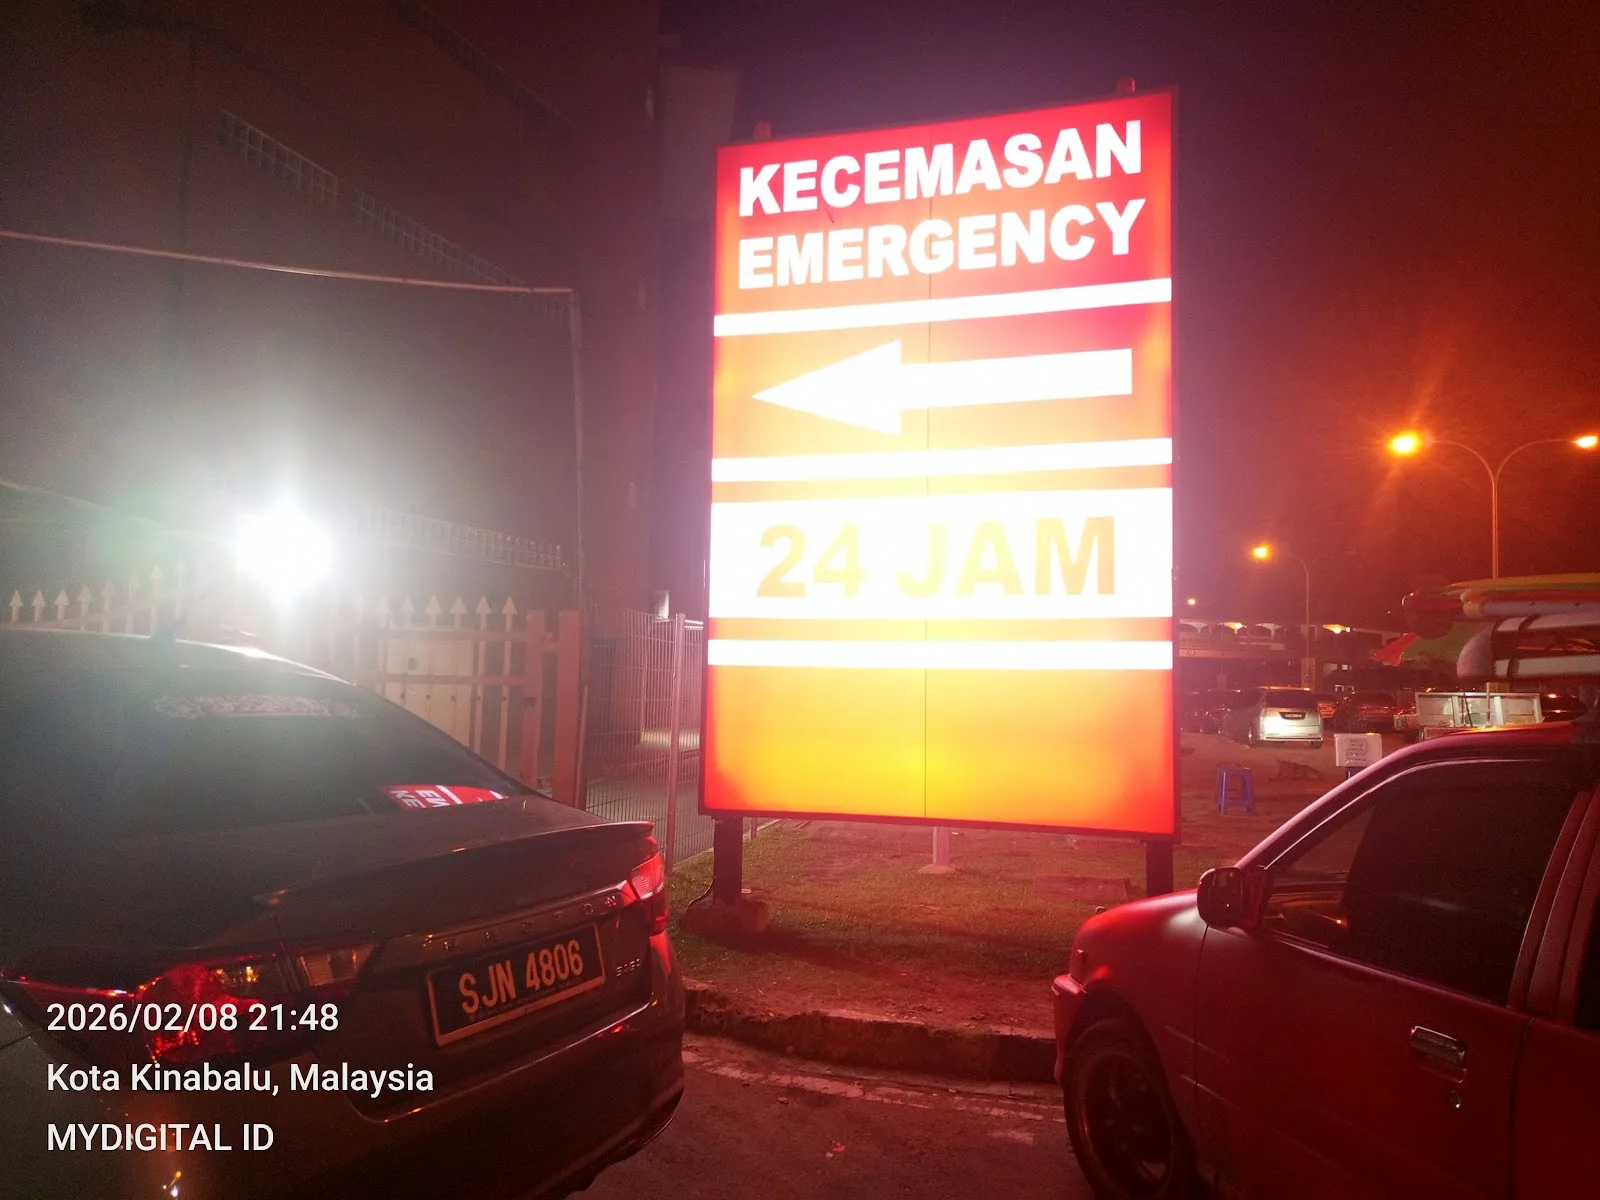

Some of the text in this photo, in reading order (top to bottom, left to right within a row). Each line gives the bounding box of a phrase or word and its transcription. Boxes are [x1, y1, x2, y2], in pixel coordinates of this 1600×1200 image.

[739, 120, 1142, 217] KECEMASAN
[739, 199, 1146, 290] EMERGENCY
[756, 515, 1117, 599] 24 JAM
[458, 960, 517, 1014] SJN
[526, 940, 583, 991] 4806
